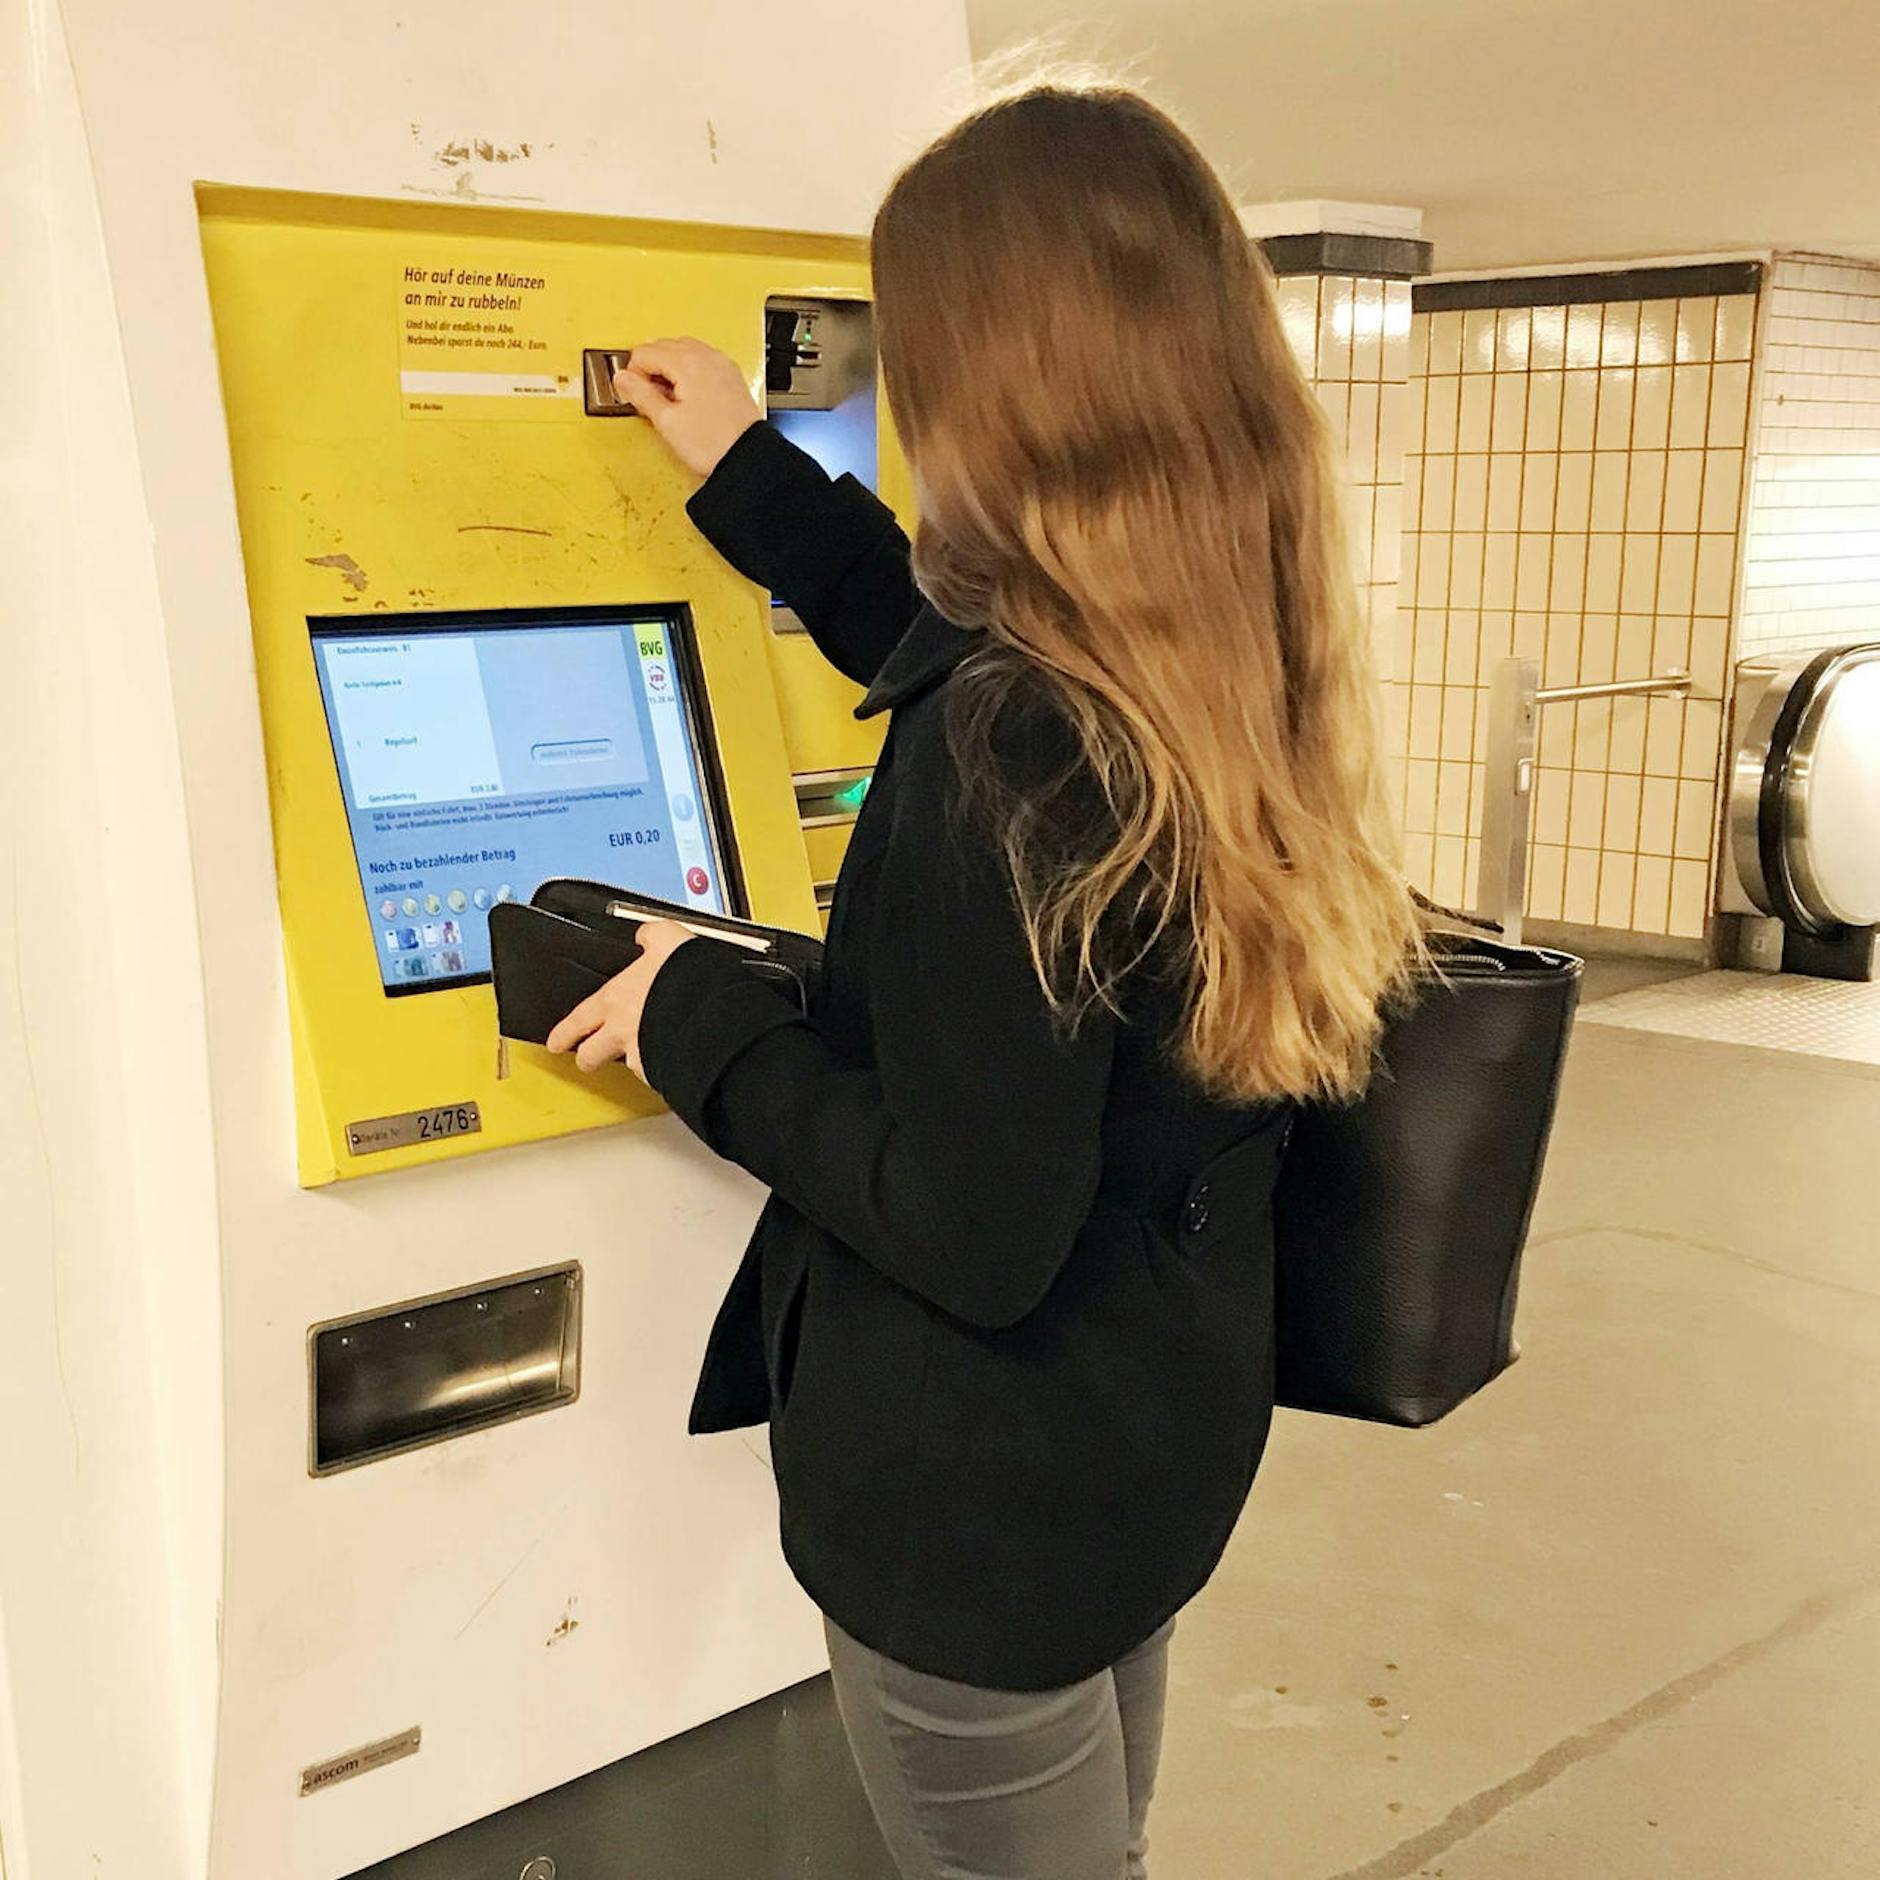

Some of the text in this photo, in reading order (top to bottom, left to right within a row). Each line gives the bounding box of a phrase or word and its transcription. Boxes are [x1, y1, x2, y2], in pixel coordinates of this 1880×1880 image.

[404, 266, 545, 290] Hör auf deine Münzen
[405, 290, 522, 311] an mir zu rubbeln!
[406, 320, 423, 330] Und
[452, 322, 482, 333] endlich
[483, 324, 496, 334] ein
[640, 641, 663, 656] BVG
[609, 828, 660, 847] EUR 0,20
[369, 848, 516, 874] Noch zu bezahlender Betrag
[375, 879, 424, 894] zahlbar mit
[417, 1109, 469, 1138] 2476
[314, 1760, 359, 1784] ascom
